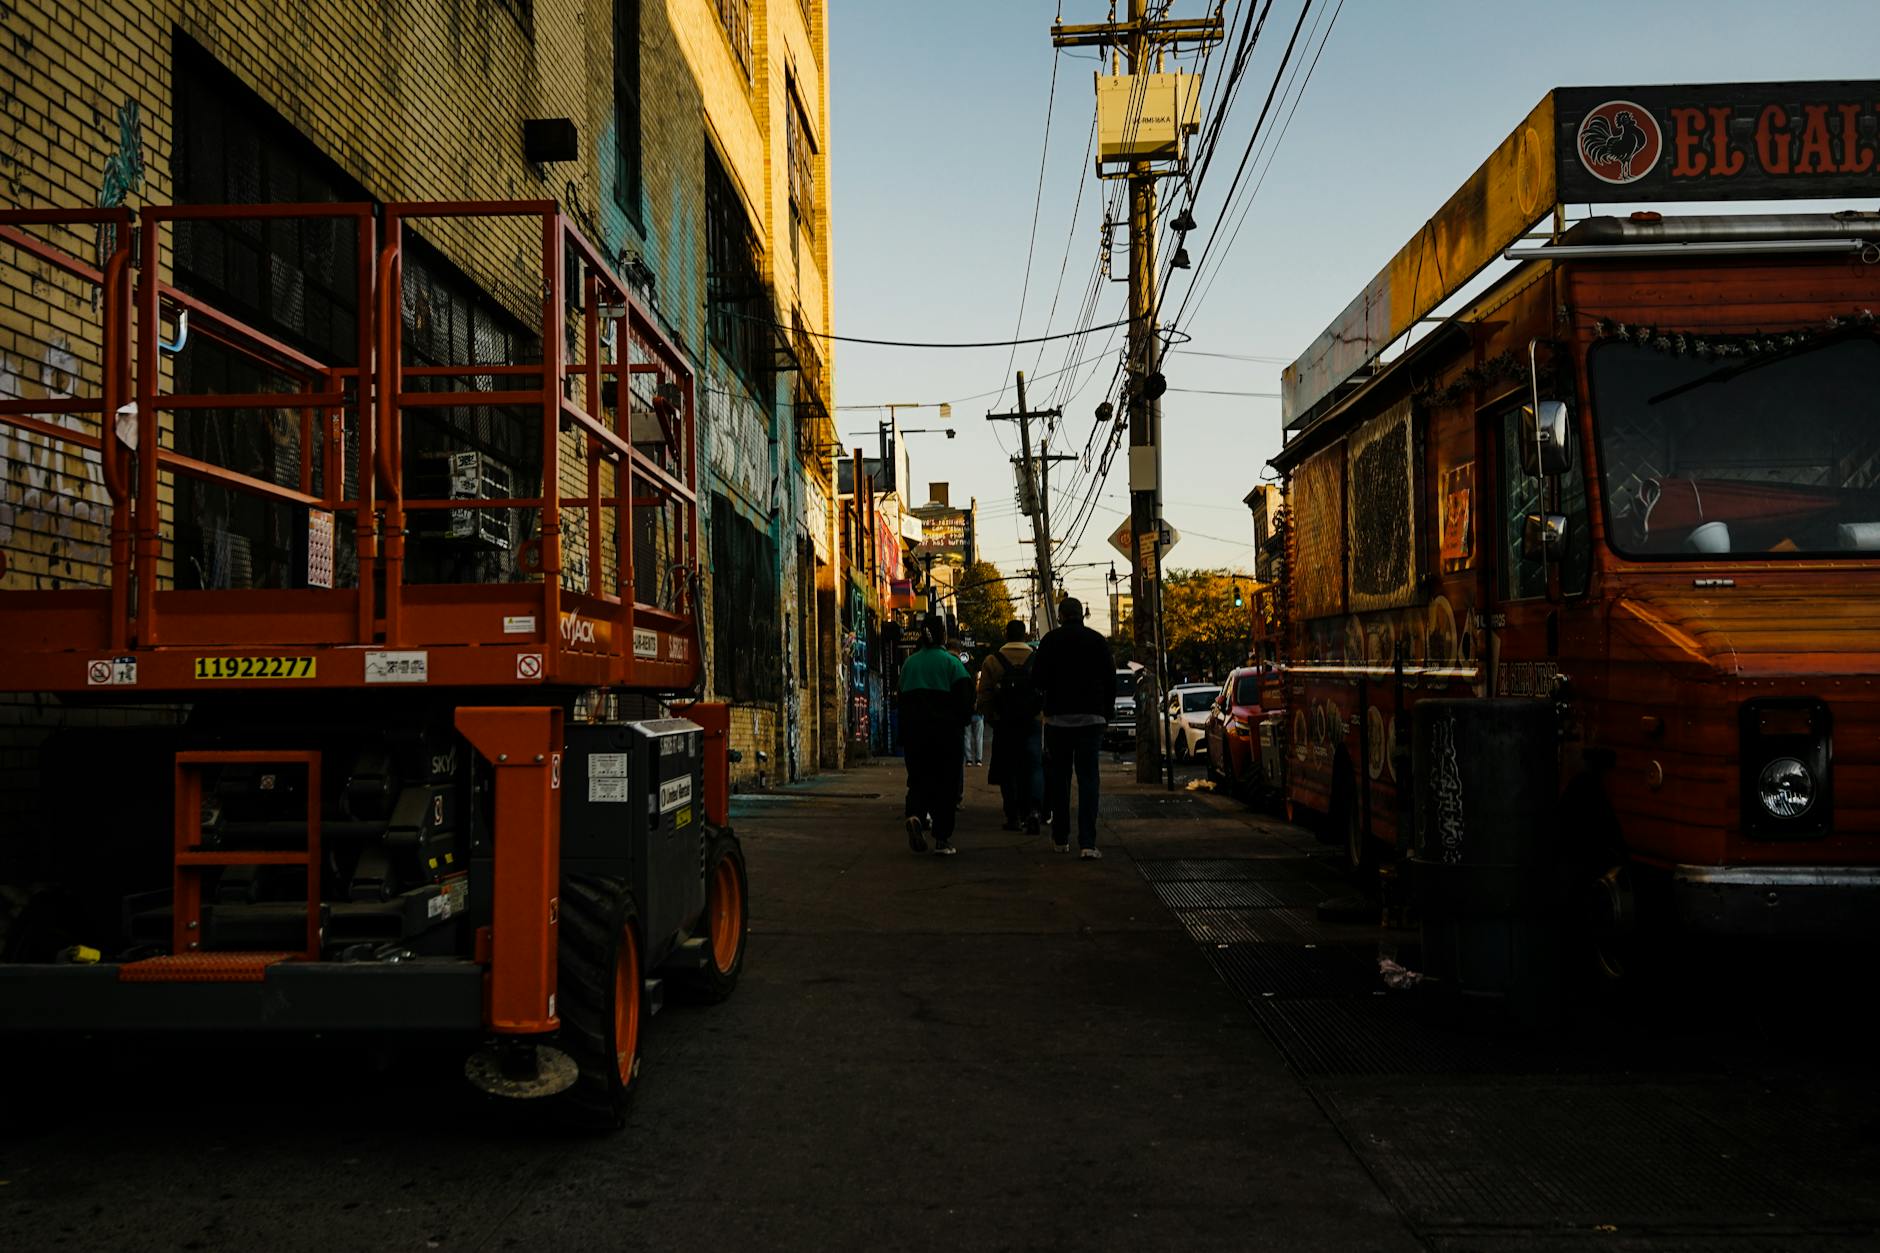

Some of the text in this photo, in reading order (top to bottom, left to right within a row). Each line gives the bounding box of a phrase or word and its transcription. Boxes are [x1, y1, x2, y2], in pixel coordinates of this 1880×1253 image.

[1670, 103, 1880, 177] EL GAL
[560, 607, 596, 646] KYJACK
[197, 656, 314, 678] 11922277
